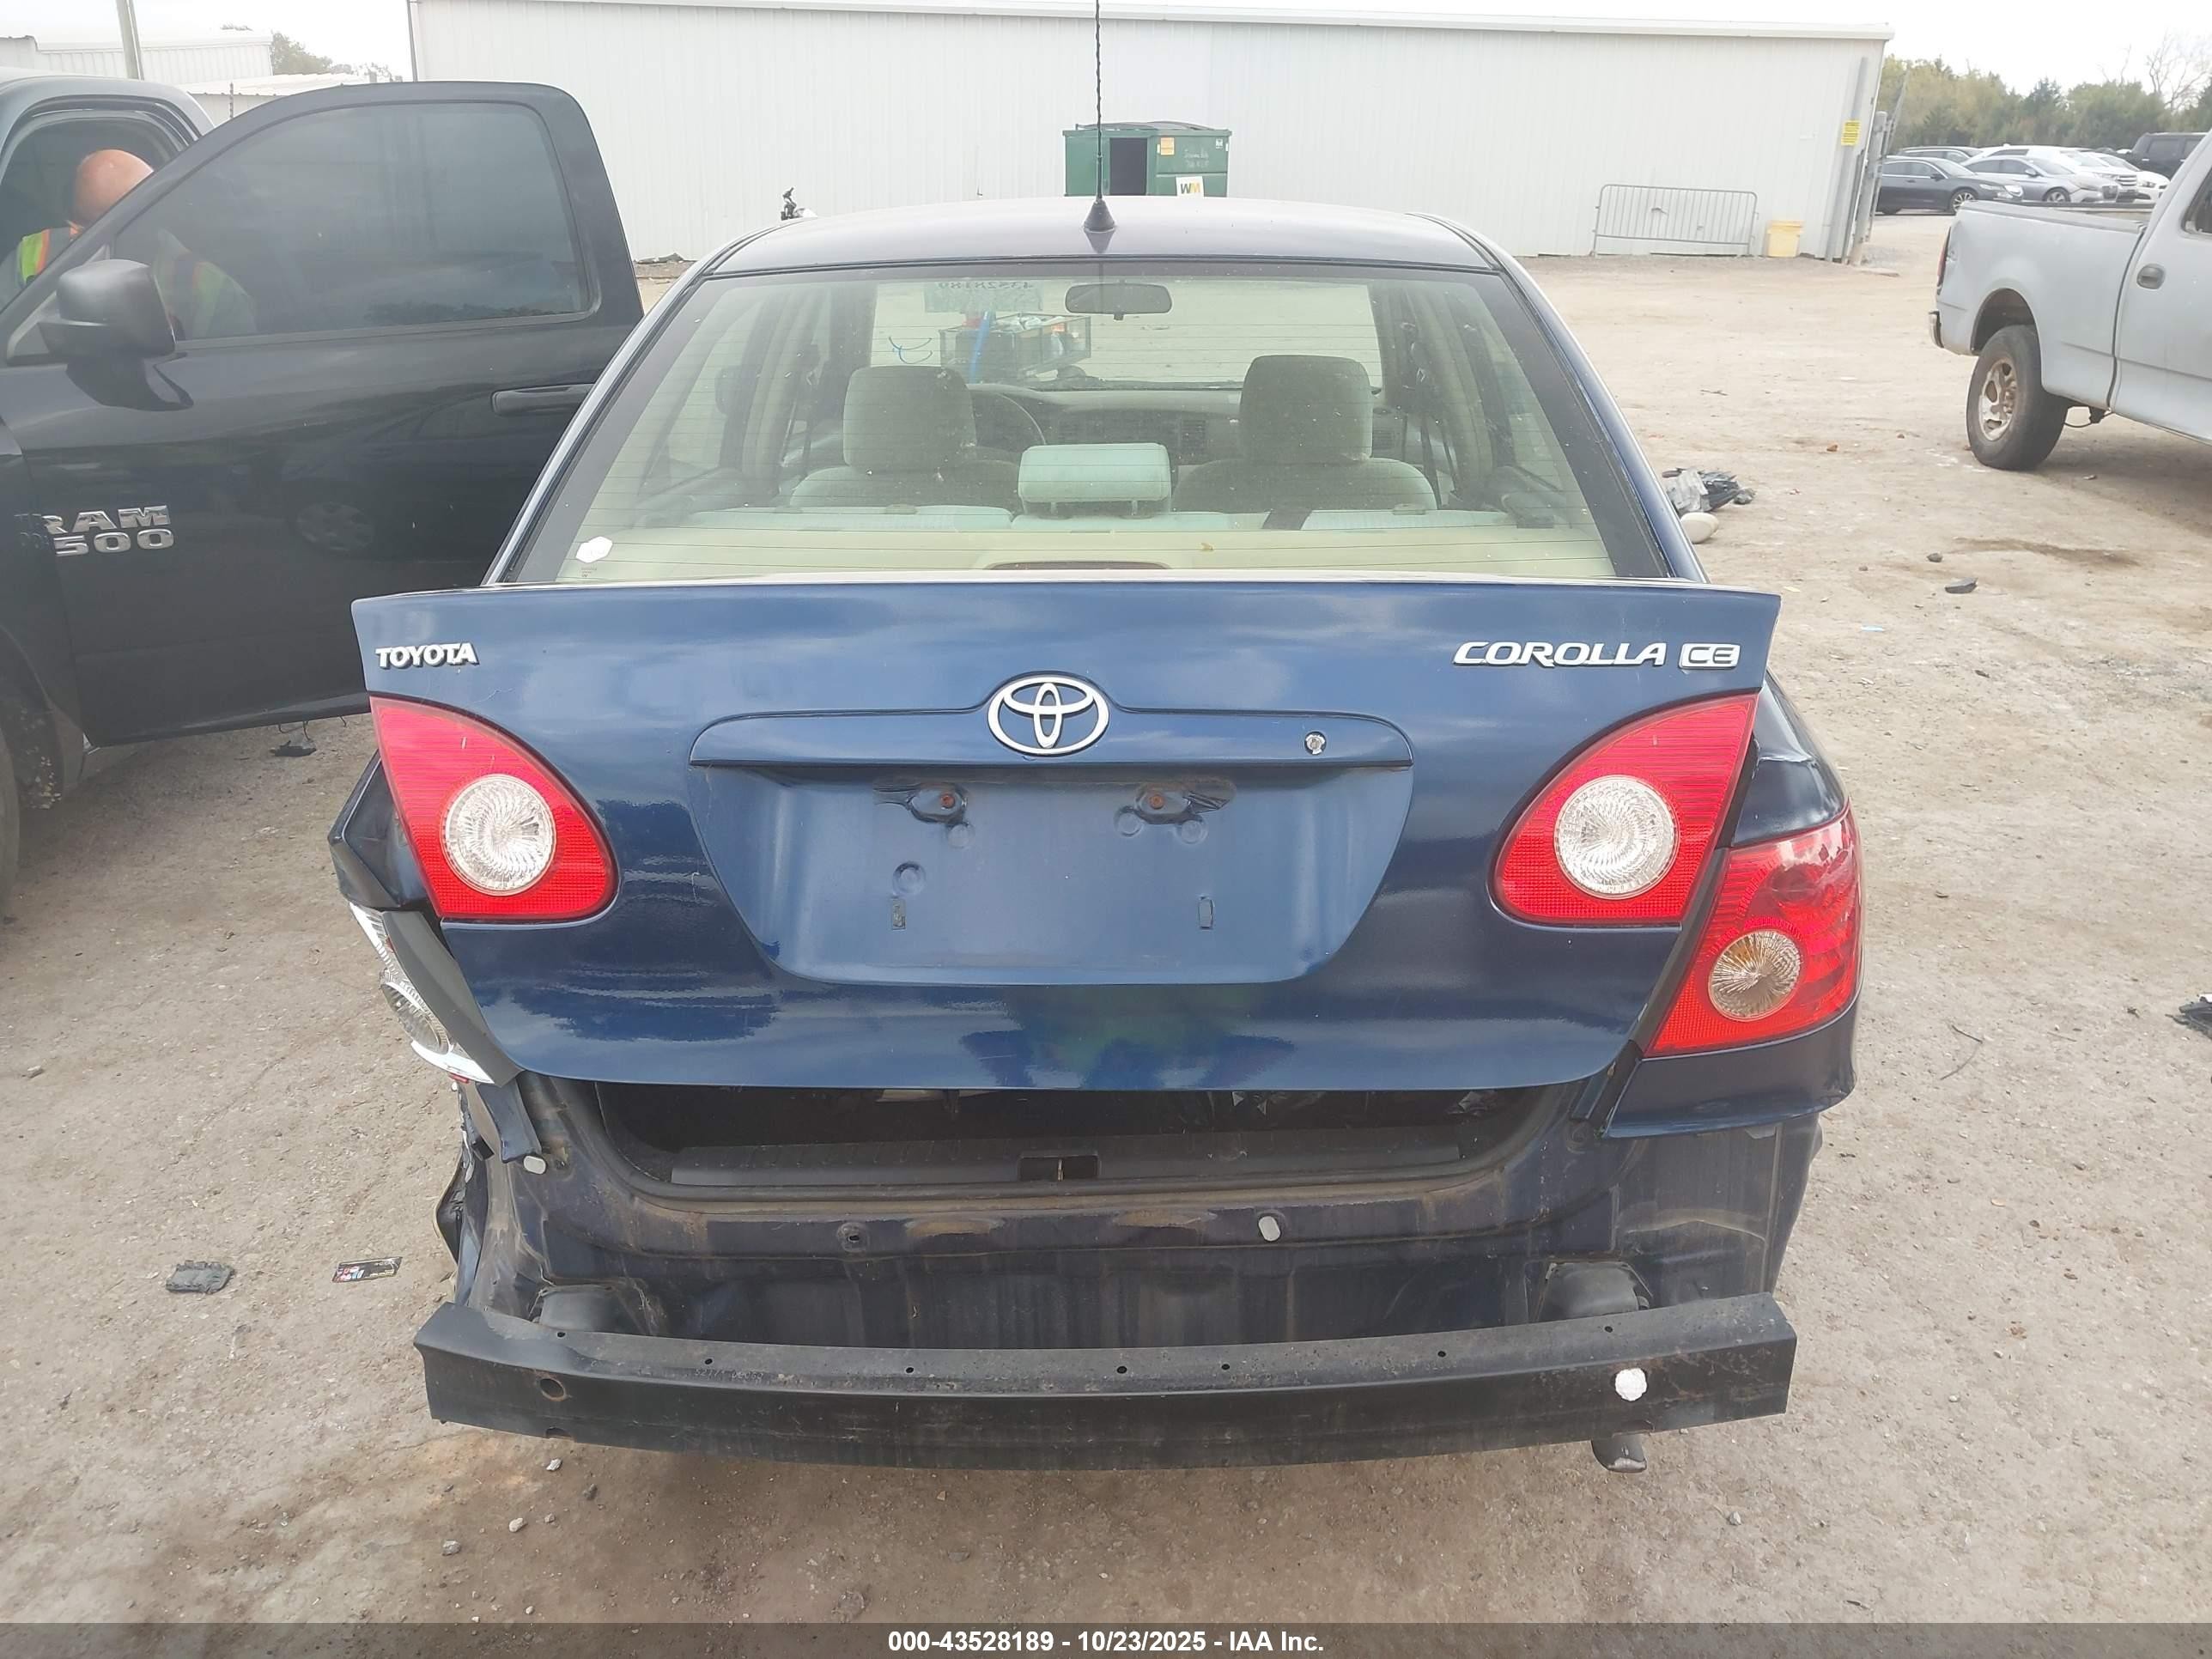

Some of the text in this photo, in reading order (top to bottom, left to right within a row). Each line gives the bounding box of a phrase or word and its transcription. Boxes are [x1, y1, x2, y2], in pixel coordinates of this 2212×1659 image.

[1180, 183, 1201, 194] WM
[375, 642, 479, 669] TOYOTA
[1453, 641, 1737, 667] COROLLA CE
